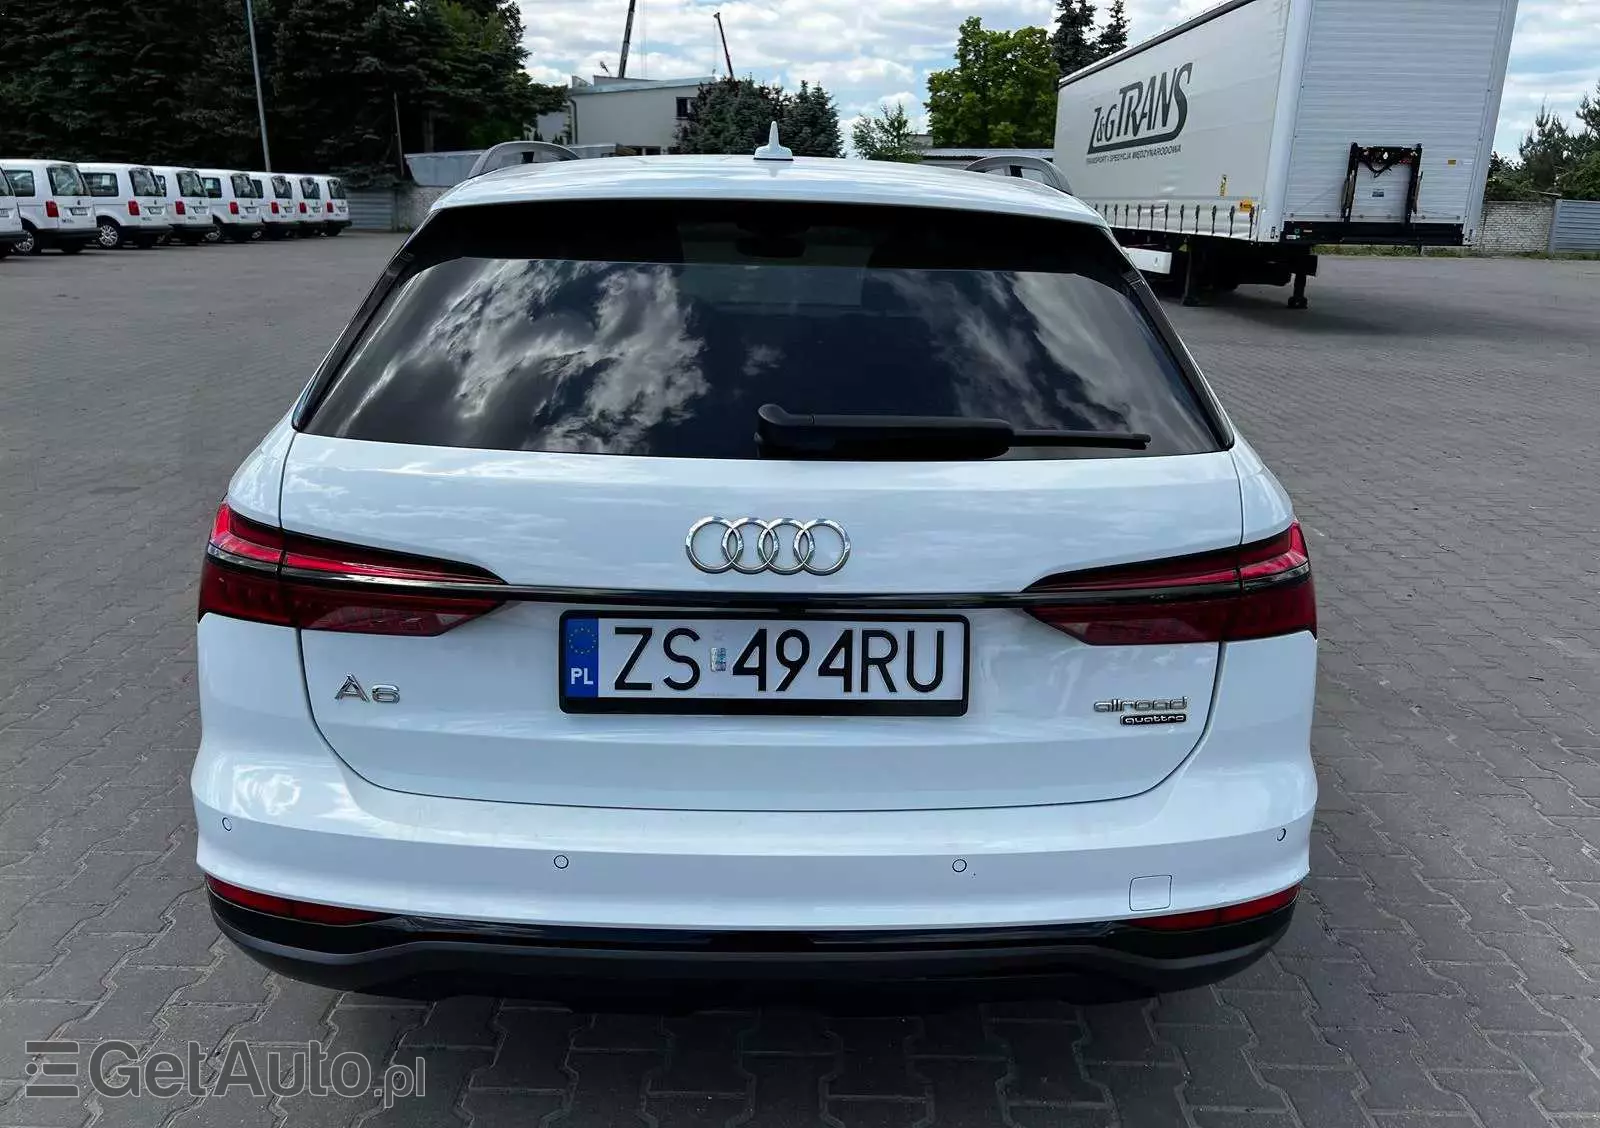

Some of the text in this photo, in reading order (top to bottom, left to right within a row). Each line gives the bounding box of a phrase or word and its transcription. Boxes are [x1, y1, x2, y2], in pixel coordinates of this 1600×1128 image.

[613, 626, 944, 694] ZS 494RU
[570, 667, 594, 685] PL
[334, 673, 401, 704] A6
[1093, 696, 1188, 713] allroad
[1123, 714, 1186, 725] quattro
